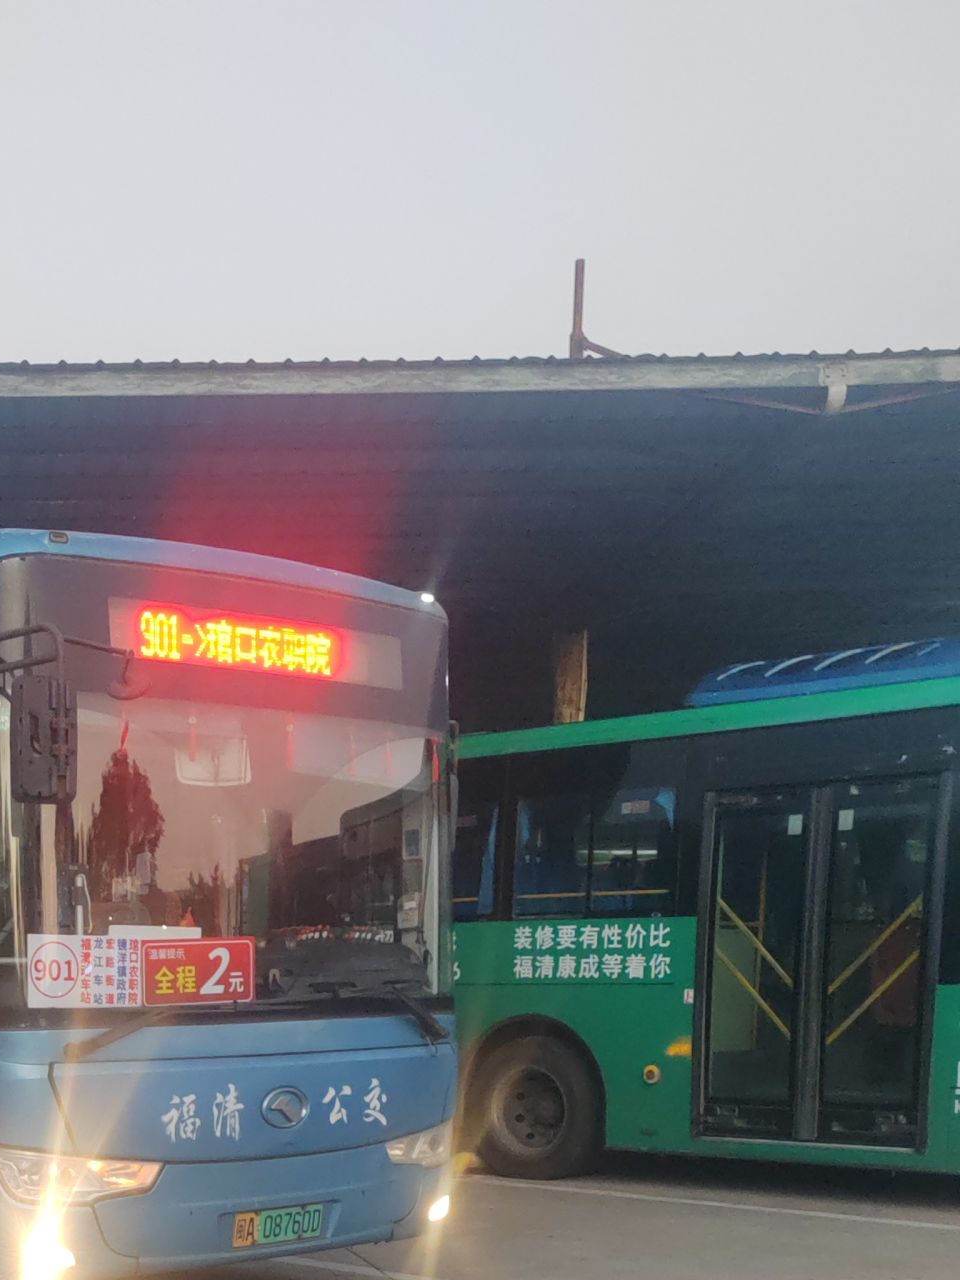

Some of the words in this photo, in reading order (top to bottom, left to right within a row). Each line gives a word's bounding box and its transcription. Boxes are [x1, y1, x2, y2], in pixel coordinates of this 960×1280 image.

[513, 923, 672, 950] 装修要有性价比
[33, 959, 76, 982] 901
[93, 937, 104, 1005] 龙江车站
[155, 965, 197, 995] 全程
[513, 953, 672, 980] 福清康成等着你
